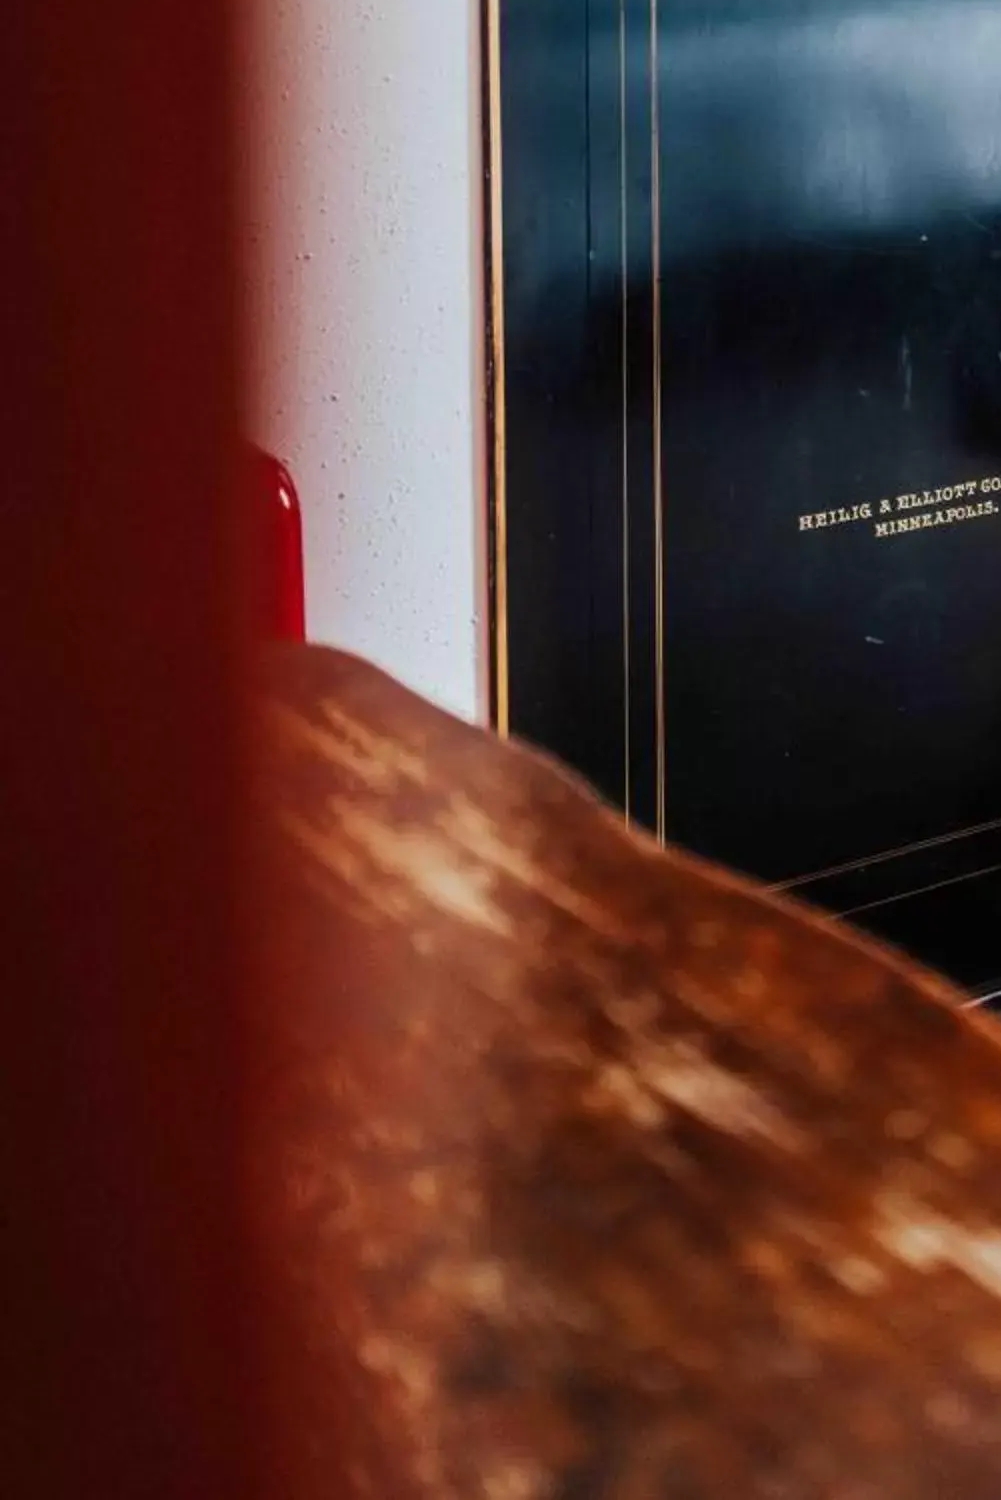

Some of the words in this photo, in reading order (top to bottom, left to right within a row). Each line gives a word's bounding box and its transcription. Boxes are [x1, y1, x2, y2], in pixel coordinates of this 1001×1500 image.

[799, 503, 873, 531] HEILIG
[880, 499, 892, 514] &
[896, 482, 977, 510] ELLIOTT
[874, 501, 1000, 537] MINNEAPOLIS.
